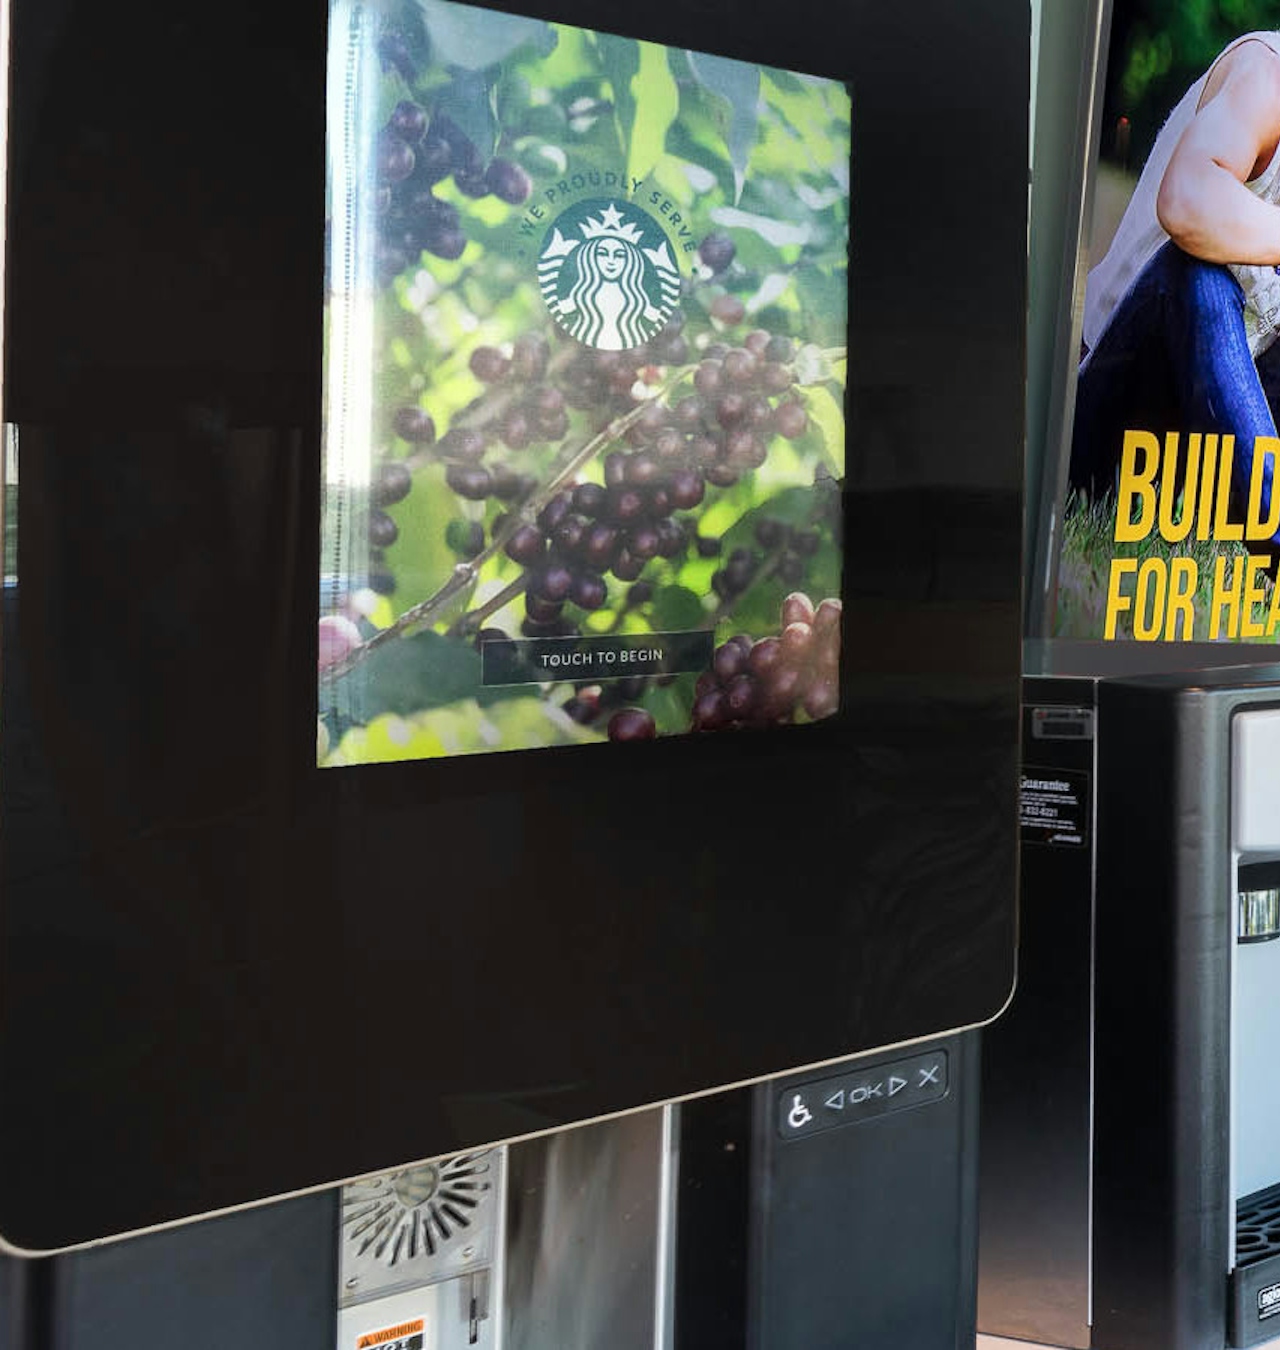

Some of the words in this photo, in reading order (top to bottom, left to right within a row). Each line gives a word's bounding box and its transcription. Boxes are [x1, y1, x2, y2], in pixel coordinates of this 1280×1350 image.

[519, 205, 544, 237] WE
[544, 172, 643, 203] PROUDLY
[649, 191, 696, 253] SERVE
[1103, 556, 1199, 642] FOR
[541, 652, 593, 667] TOUCH
[597, 651, 617, 664] TO
[620, 649, 664, 663] BEGIN
[850, 1083, 883, 1104] OK
[376, 1321, 422, 1342] WARNING
